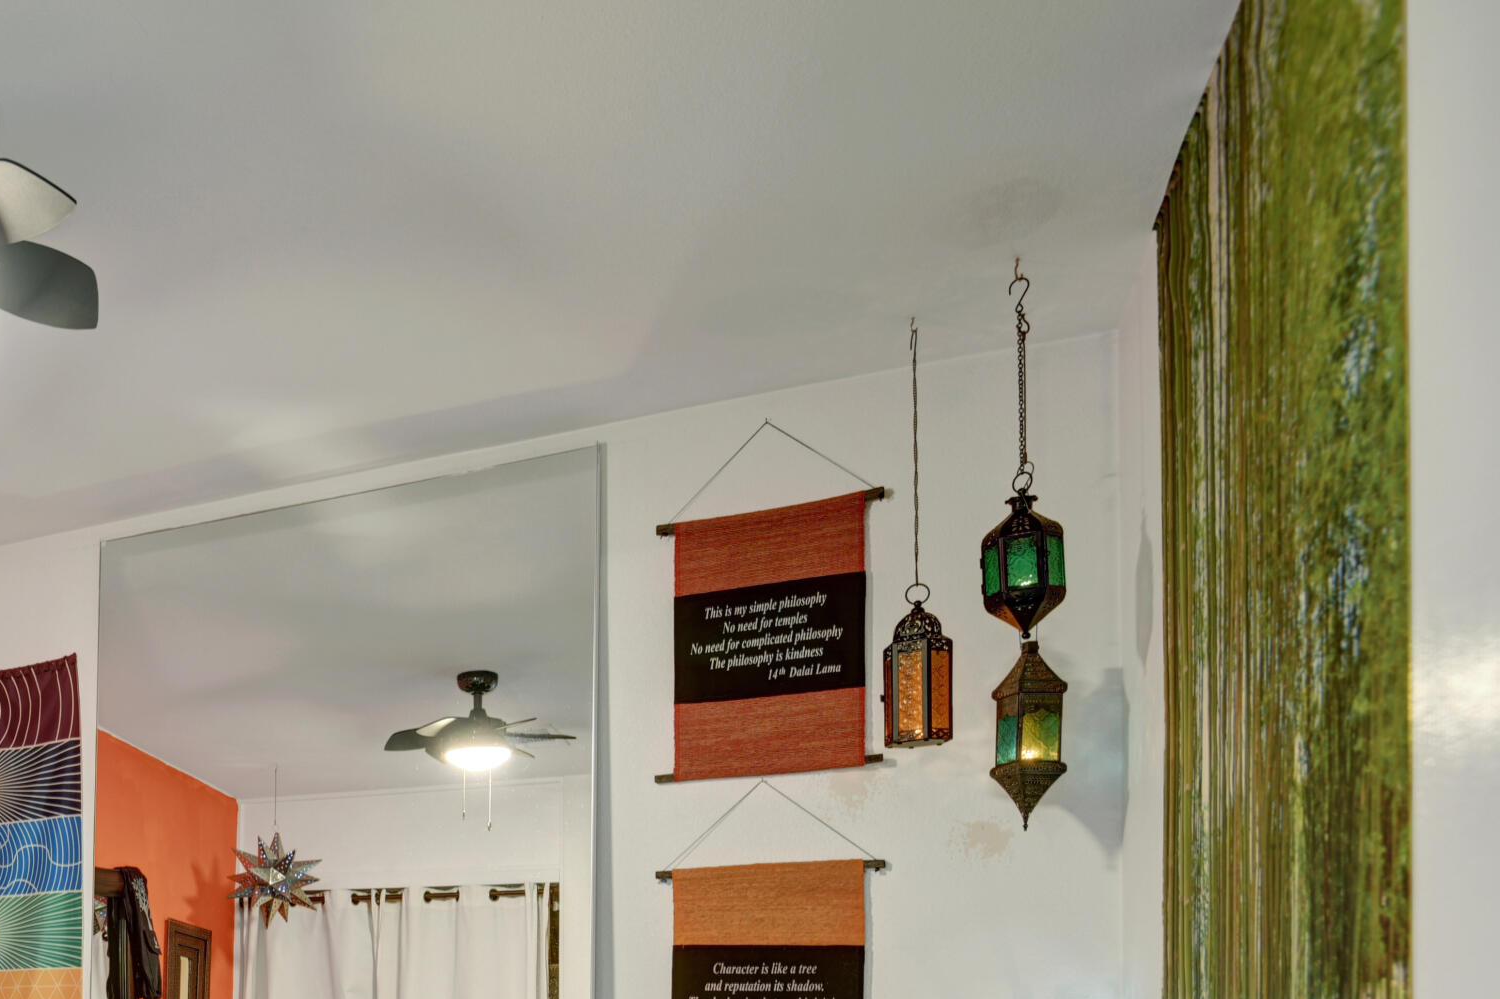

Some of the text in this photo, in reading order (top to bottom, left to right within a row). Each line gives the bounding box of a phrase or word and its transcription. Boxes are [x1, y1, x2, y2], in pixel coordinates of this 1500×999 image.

[705, 591, 827, 620] This is my simple philosophy
[722, 611, 808, 634] No need for temples
[690, 624, 843, 655] No need for complicated philosophy
[710, 645, 824, 671] The philosophy is kindness
[789, 664, 814, 678] Dalai
[816, 663, 841, 675] Lama
[712, 962, 817, 975] Character is like a tree
[704, 979, 824, 995] and reputation its shadow.
